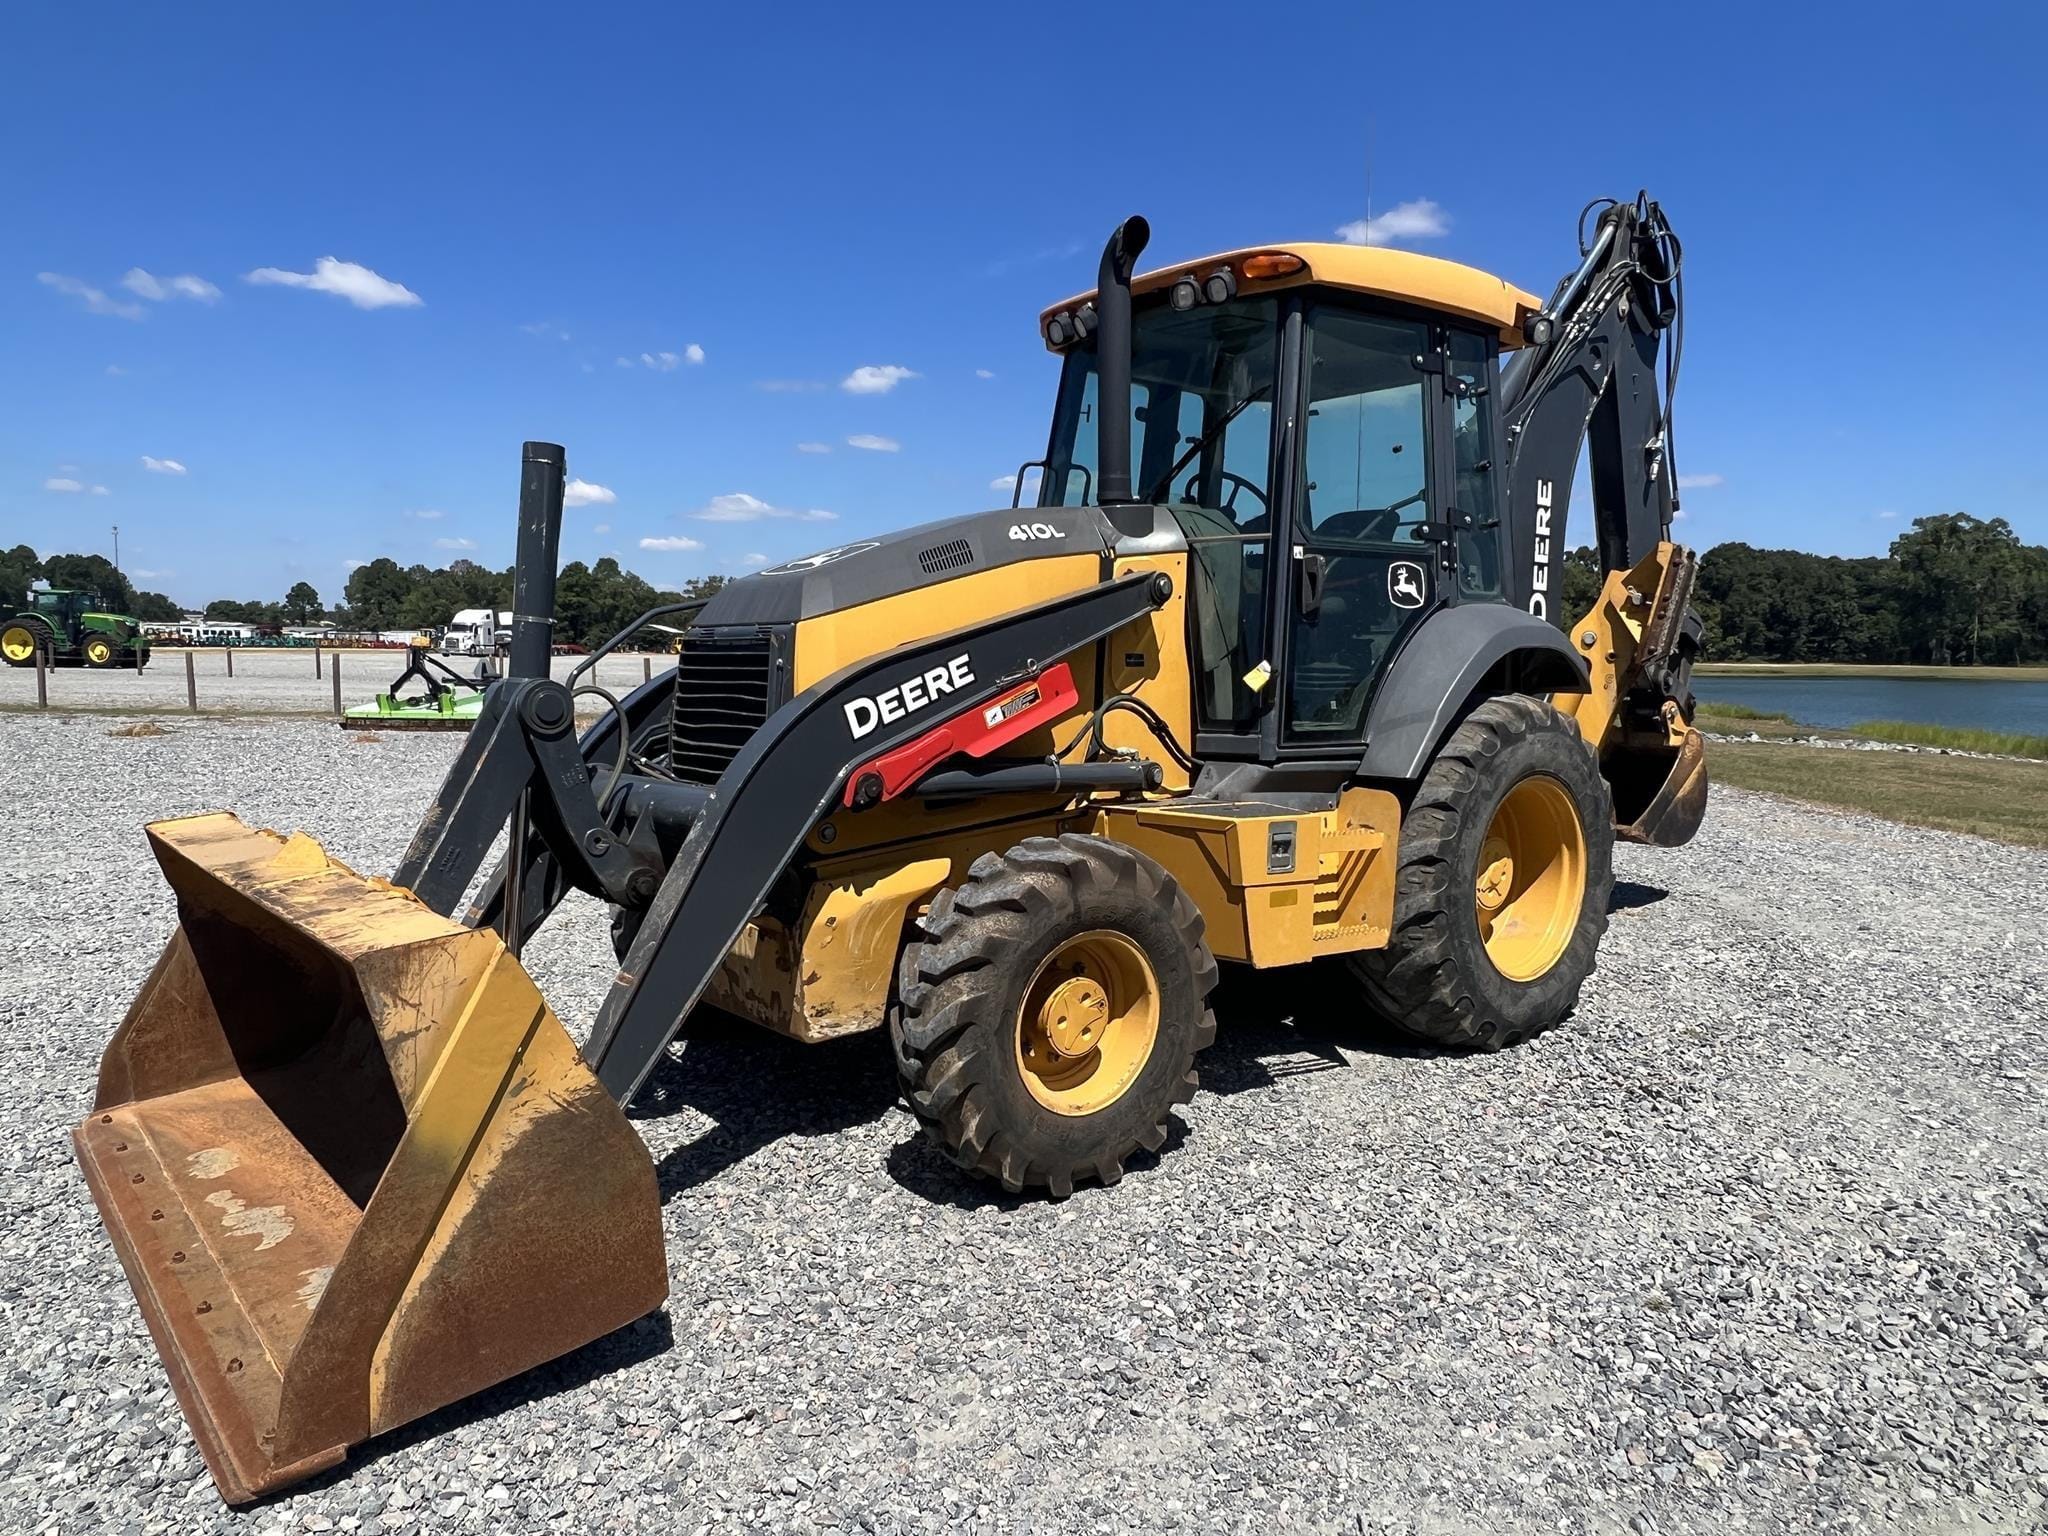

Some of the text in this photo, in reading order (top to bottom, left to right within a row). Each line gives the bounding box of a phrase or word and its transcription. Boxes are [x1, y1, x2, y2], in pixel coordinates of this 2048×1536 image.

[1008, 523, 1066, 541] 410L
[1529, 479, 1552, 622] DEERE
[843, 653, 975, 740] DEERE
